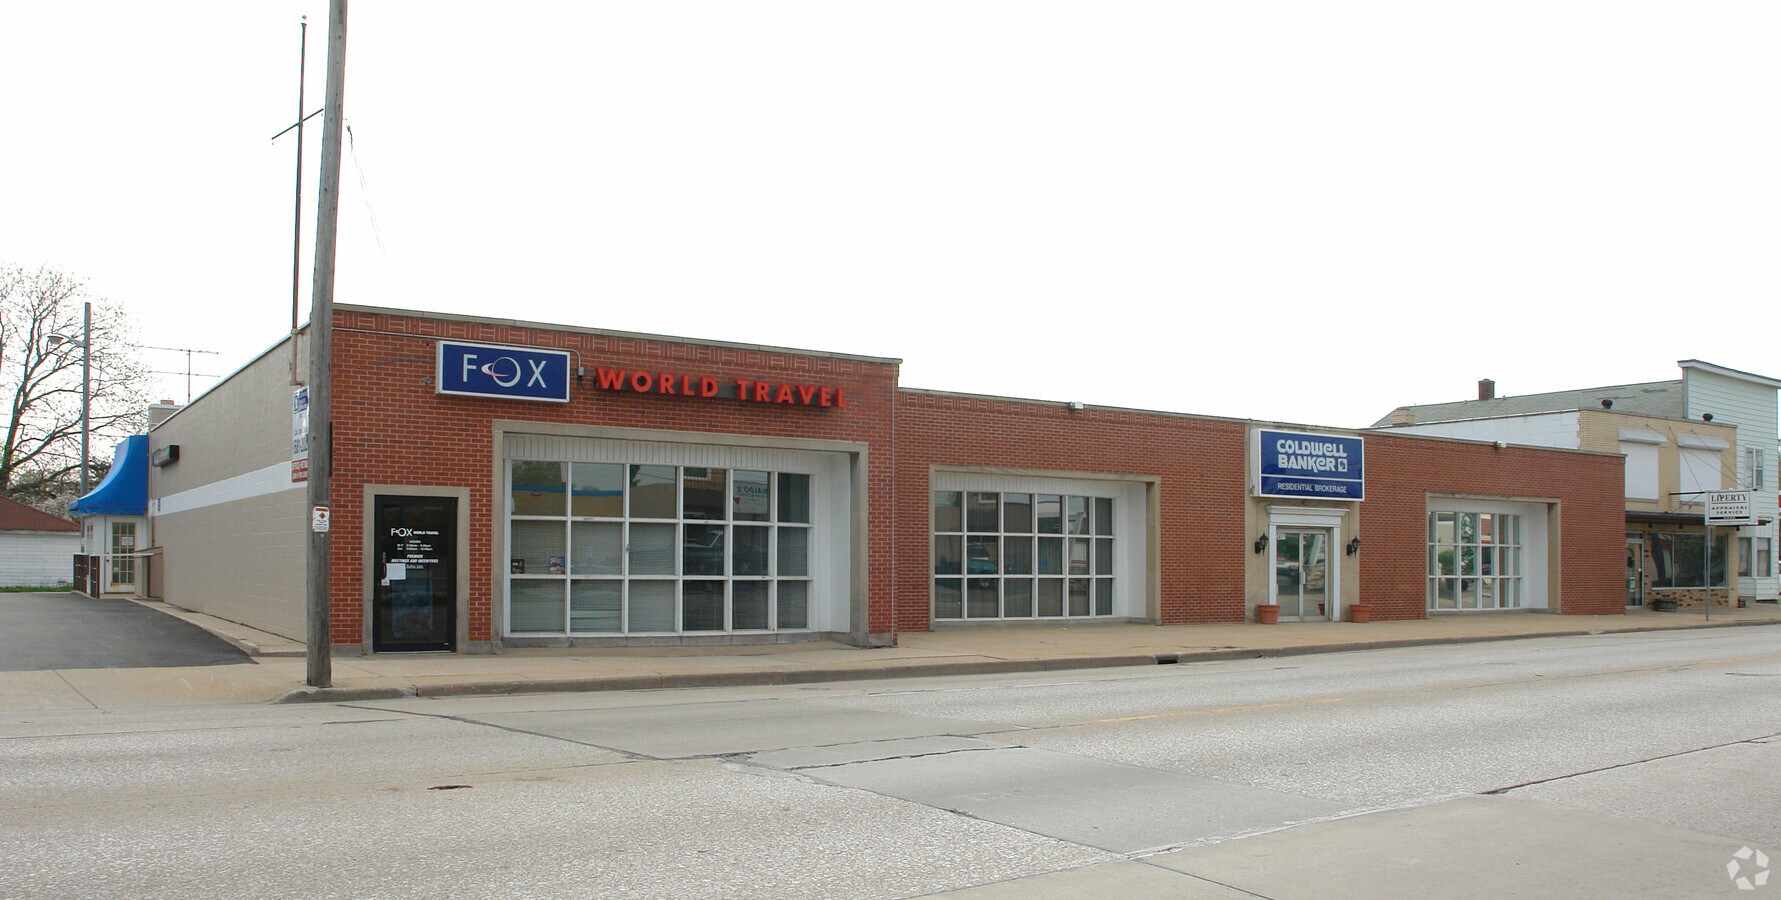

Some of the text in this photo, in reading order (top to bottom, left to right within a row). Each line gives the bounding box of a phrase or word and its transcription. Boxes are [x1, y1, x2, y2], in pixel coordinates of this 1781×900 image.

[462, 353, 547, 389] FOX
[595, 367, 849, 408] WORLD TRAVEL
[1276, 439, 1348, 458] COLDWELL
[1277, 454, 1336, 473] BANKER
[1277, 482, 1348, 494] RESIDENTIAL BROKERAGE
[1711, 494, 1748, 502] LIBERTY
[390, 527, 413, 537] FOX
